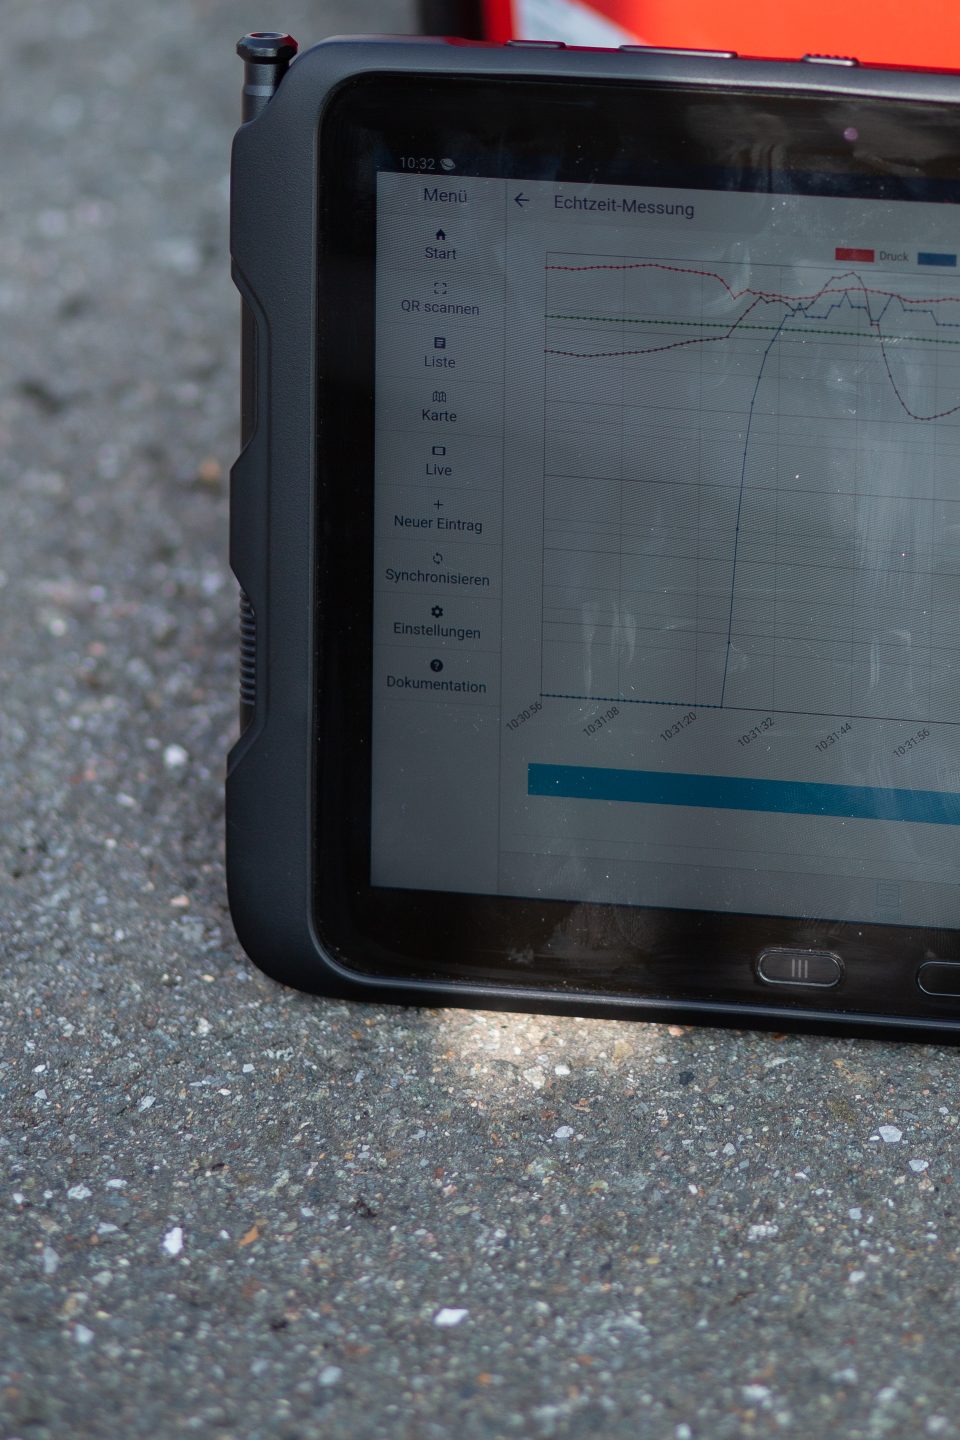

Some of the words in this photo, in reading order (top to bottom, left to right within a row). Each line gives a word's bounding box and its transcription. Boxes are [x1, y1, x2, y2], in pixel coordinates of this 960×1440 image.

[400, 157, 436, 170] 10:32
[424, 188, 467, 204] Menü
[554, 195, 695, 219] Echtzeit-Messung
[425, 247, 456, 260] Start
[879, 251, 909, 262] Druck
[401, 299, 420, 312] QR
[423, 303, 480, 316] scannen
[424, 356, 456, 369] Liste
[422, 410, 457, 423] Karte
[426, 464, 452, 476] Live
[394, 515, 434, 529] Neuer
[437, 518, 483, 534] Eintrag
[385, 569, 490, 587] Synchronisieren
[393, 622, 481, 640] Einstellungen
[387, 676, 487, 693] Dokumentation
[505, 700, 543, 733] 10:30:56
[582, 706, 620, 738] 10:31:08
[659, 711, 698, 744] 10:31:20
[737, 717, 775, 748] 10:31:32
[814, 722, 853, 754] 10:31:44
[892, 727, 931, 759] 10:31:56
